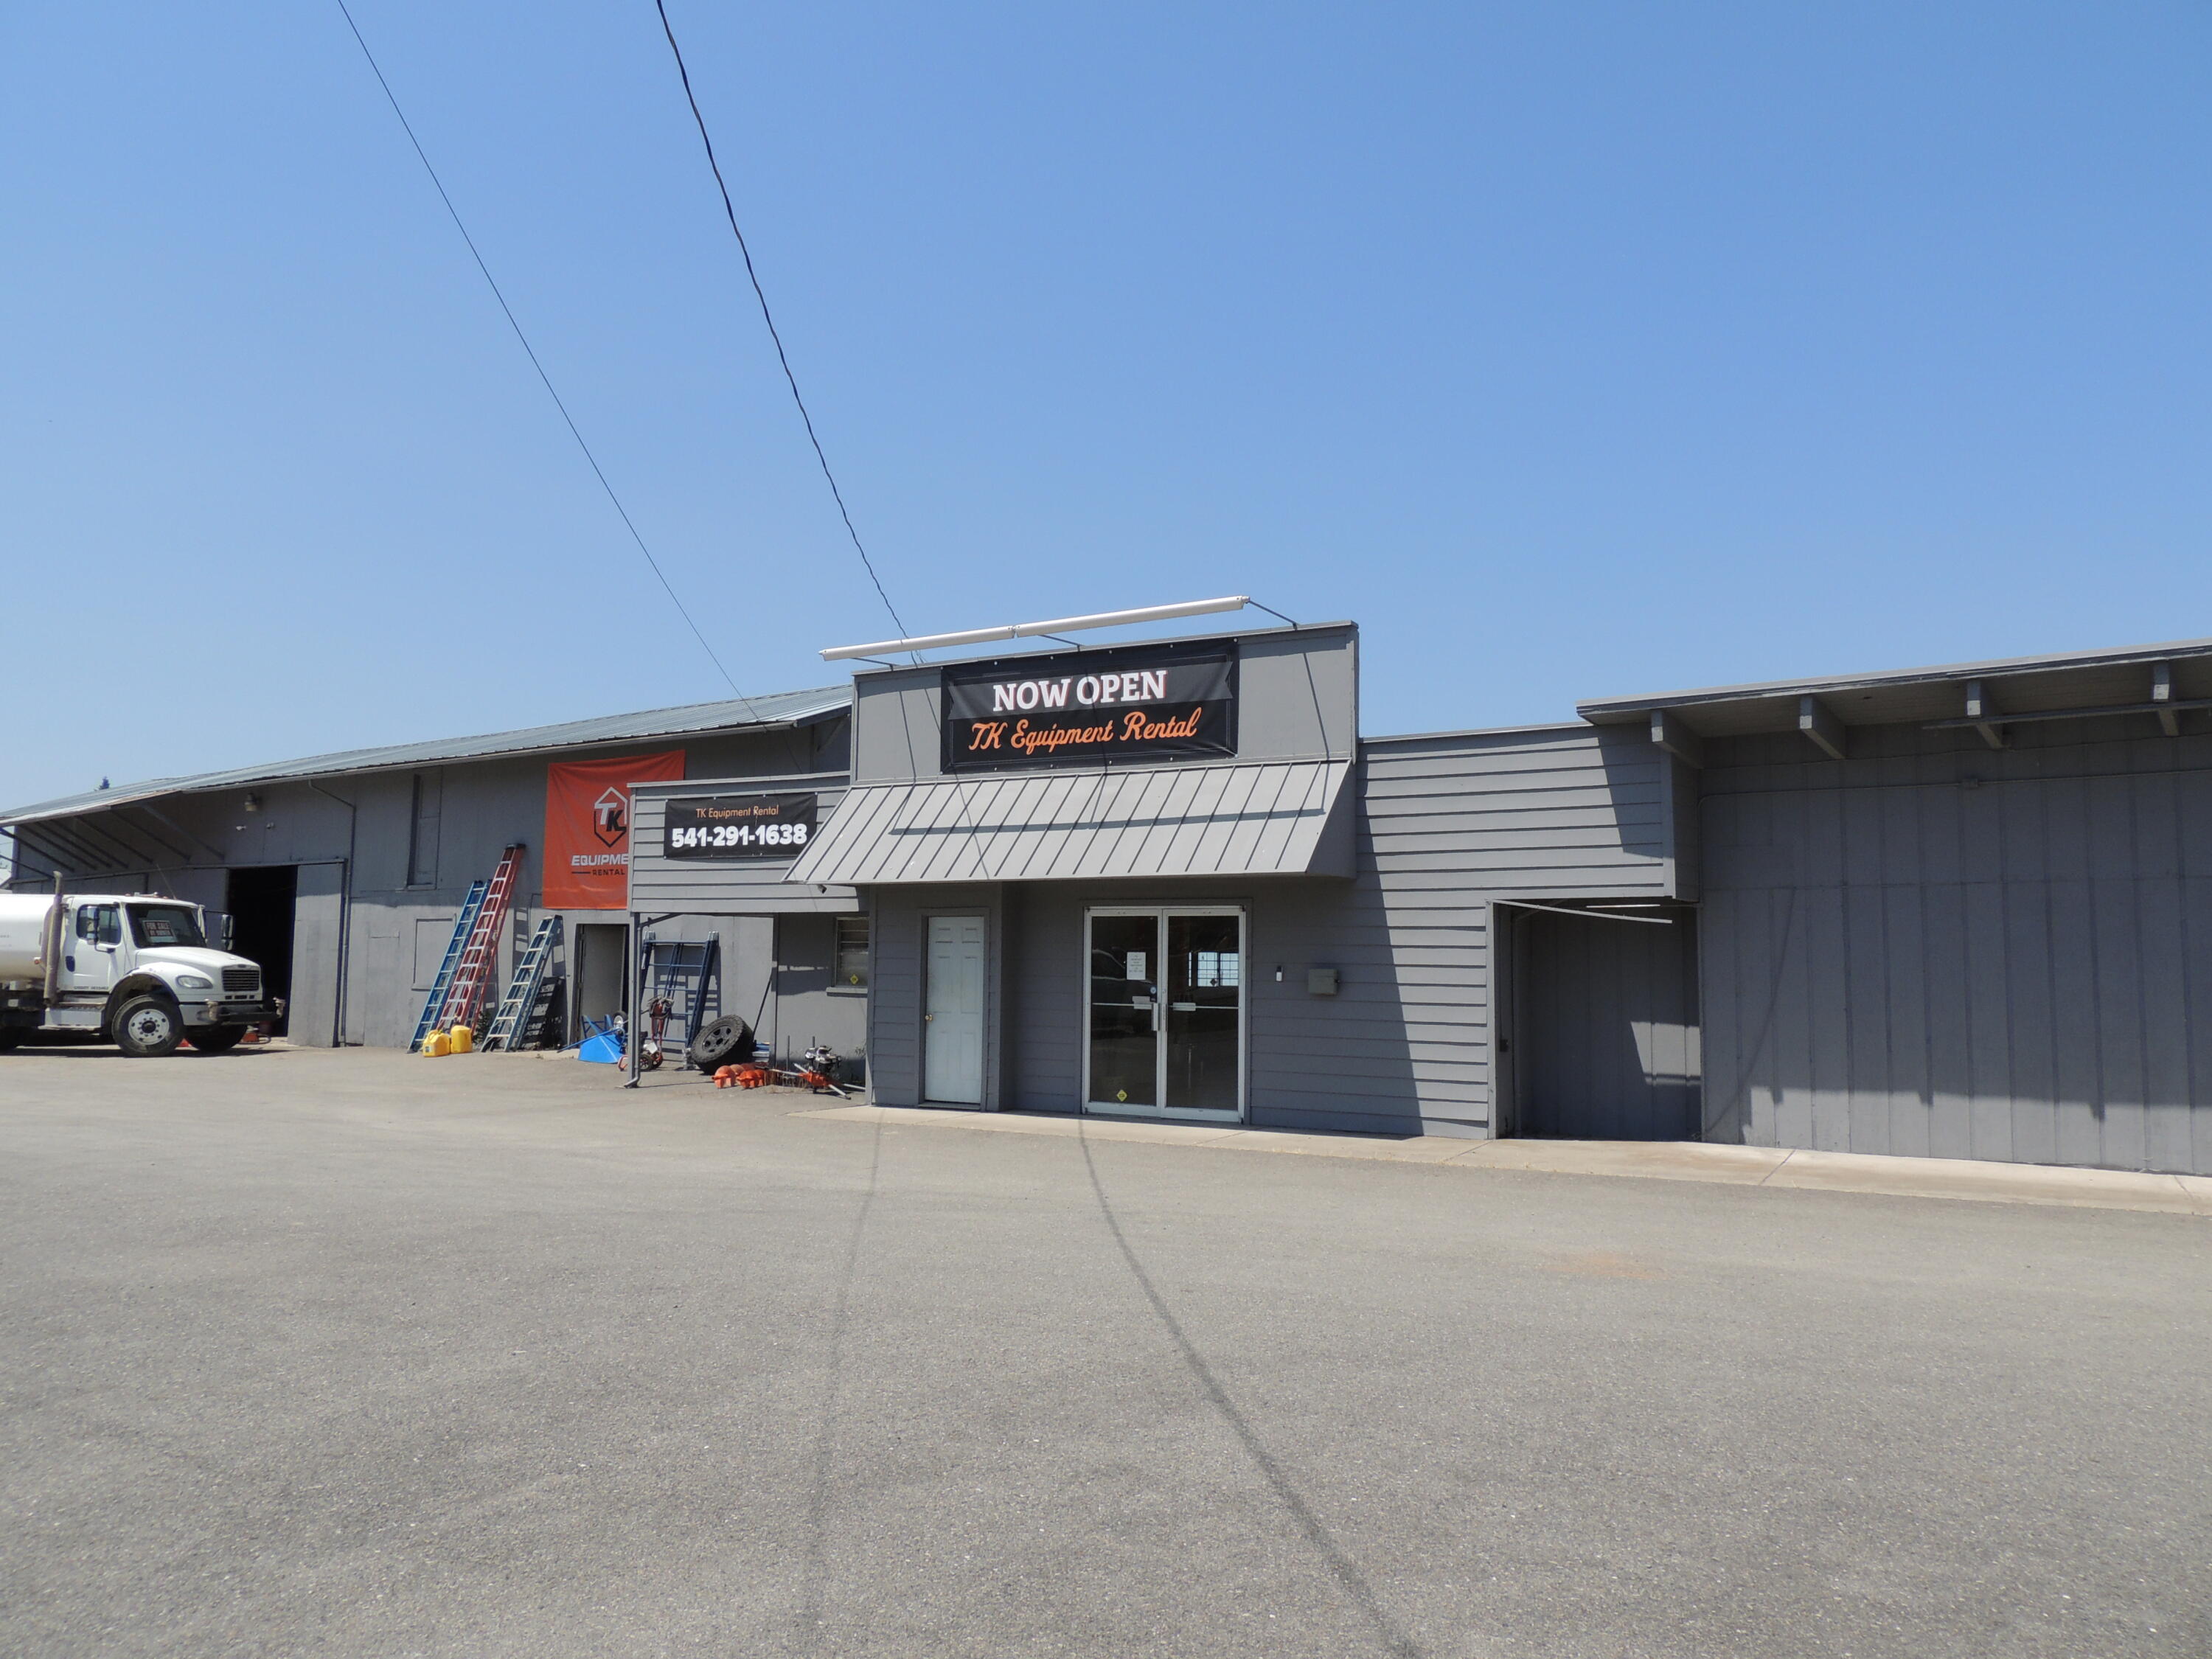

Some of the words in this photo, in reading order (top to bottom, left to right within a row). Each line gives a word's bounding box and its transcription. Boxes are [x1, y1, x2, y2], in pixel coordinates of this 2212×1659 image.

[992, 678, 1072, 712] NOW
[1077, 669, 1168, 705] OPEN
[968, 722, 1008, 751] TK
[1010, 719, 1114, 755] Equipment
[1119, 706, 1203, 741] Rental
[594, 802, 627, 832] TK
[696, 808, 706, 818] TK
[709, 807, 751, 819] Equipment
[754, 804, 779, 815] Rental
[672, 824, 807, 847] 541-291-1638
[571, 854, 629, 866] EQUIPME
